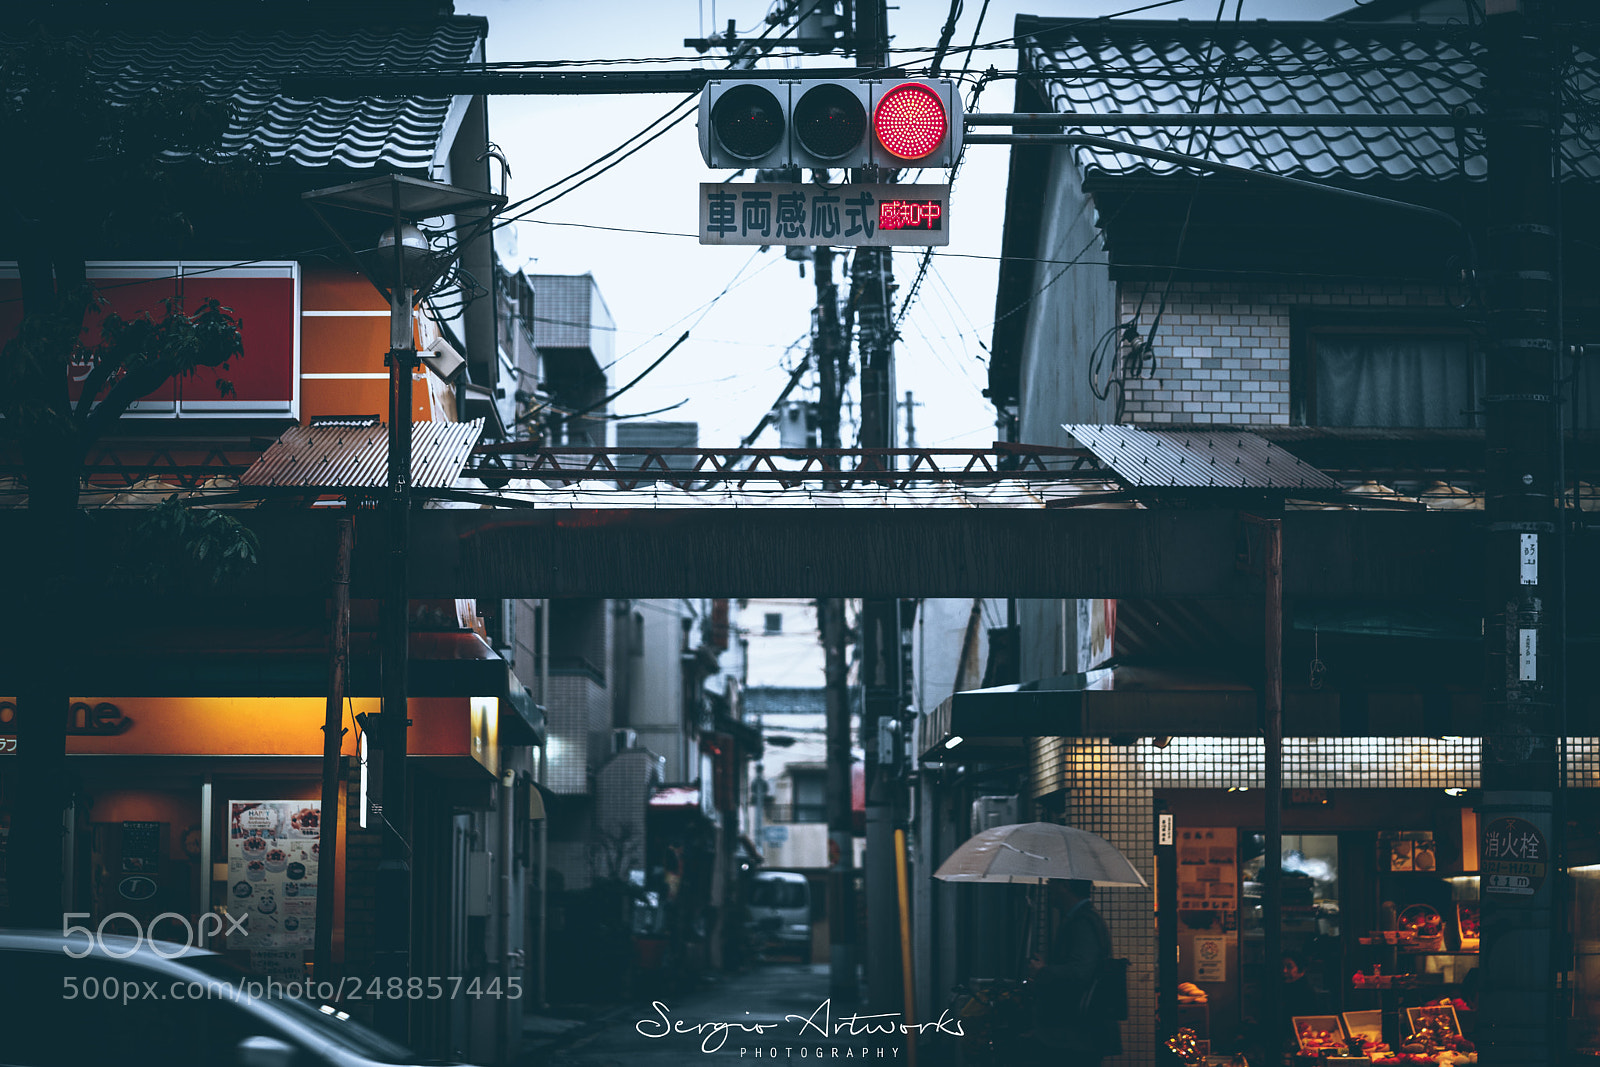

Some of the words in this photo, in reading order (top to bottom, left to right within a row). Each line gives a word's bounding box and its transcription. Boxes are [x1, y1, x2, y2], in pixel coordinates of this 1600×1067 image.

[706, 190, 875, 239] 車両感応式
[879, 199, 941, 231] 感知中
[1485, 831, 1540, 859] 消火栓
